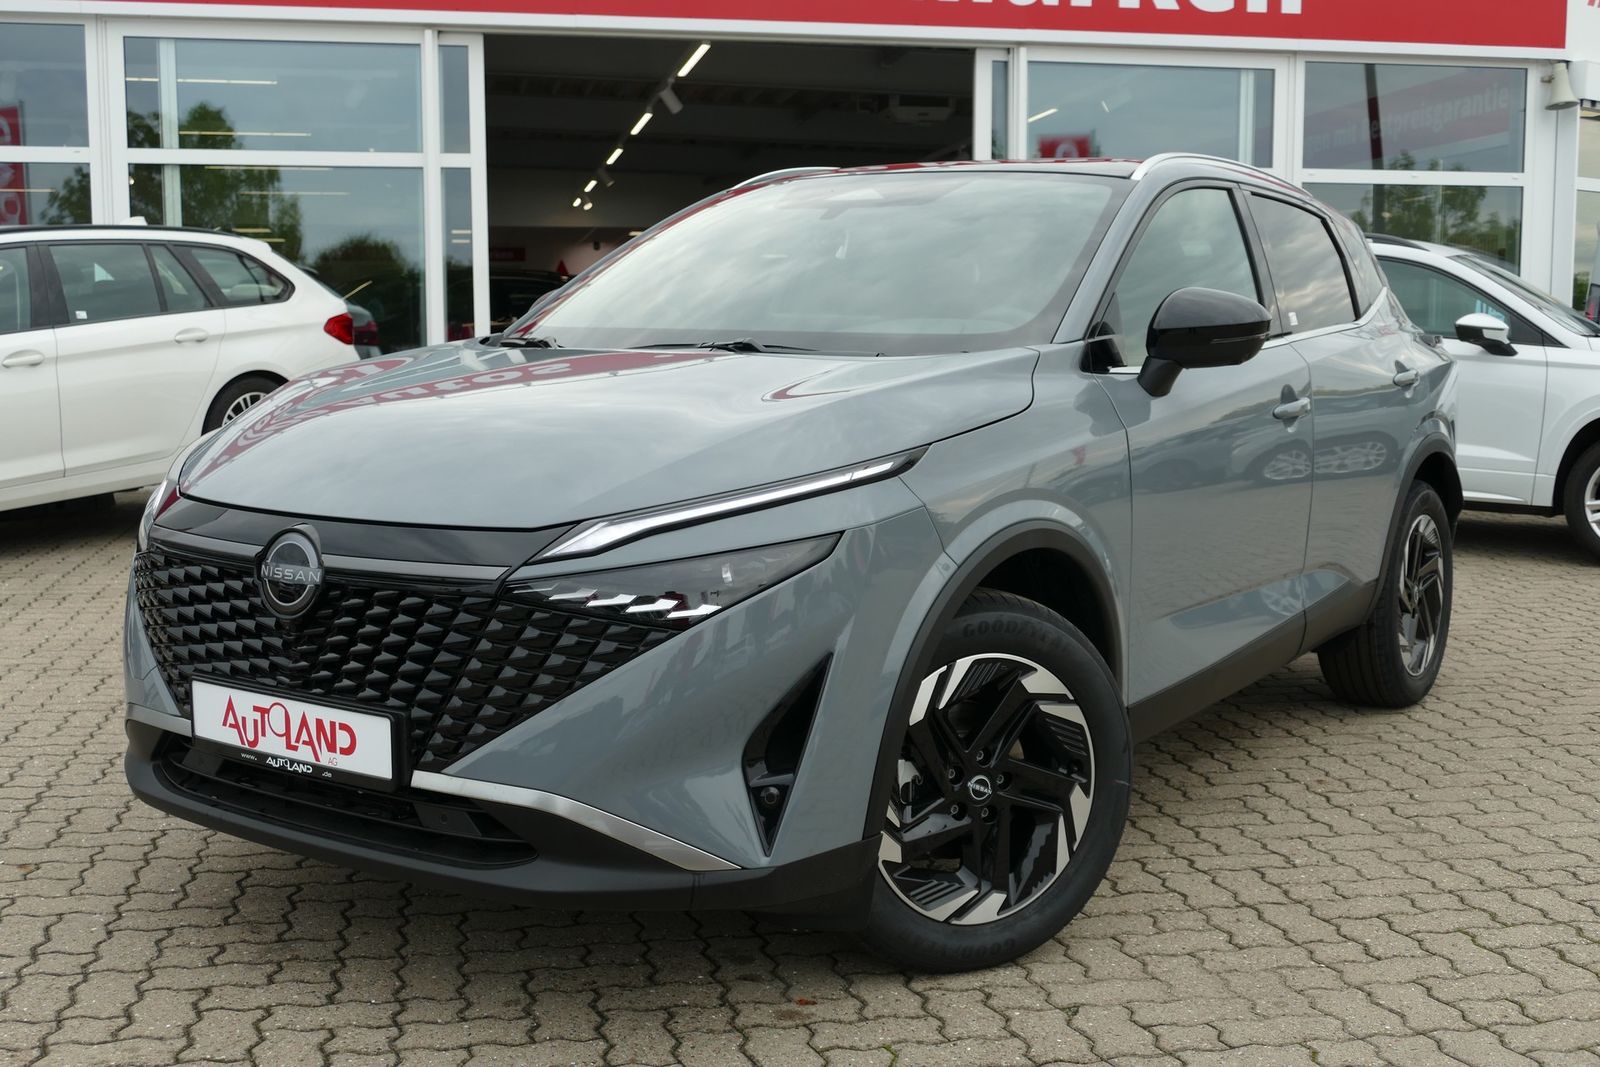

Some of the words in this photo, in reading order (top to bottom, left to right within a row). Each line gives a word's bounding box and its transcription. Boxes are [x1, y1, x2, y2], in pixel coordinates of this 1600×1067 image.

[1361, 81, 1509, 144] etpreisgarantie
[261, 564, 320, 583] NISSAN
[222, 694, 357, 762] AUTOLAND
[241, 752, 258, 761] www.
[327, 756, 338, 766] AG
